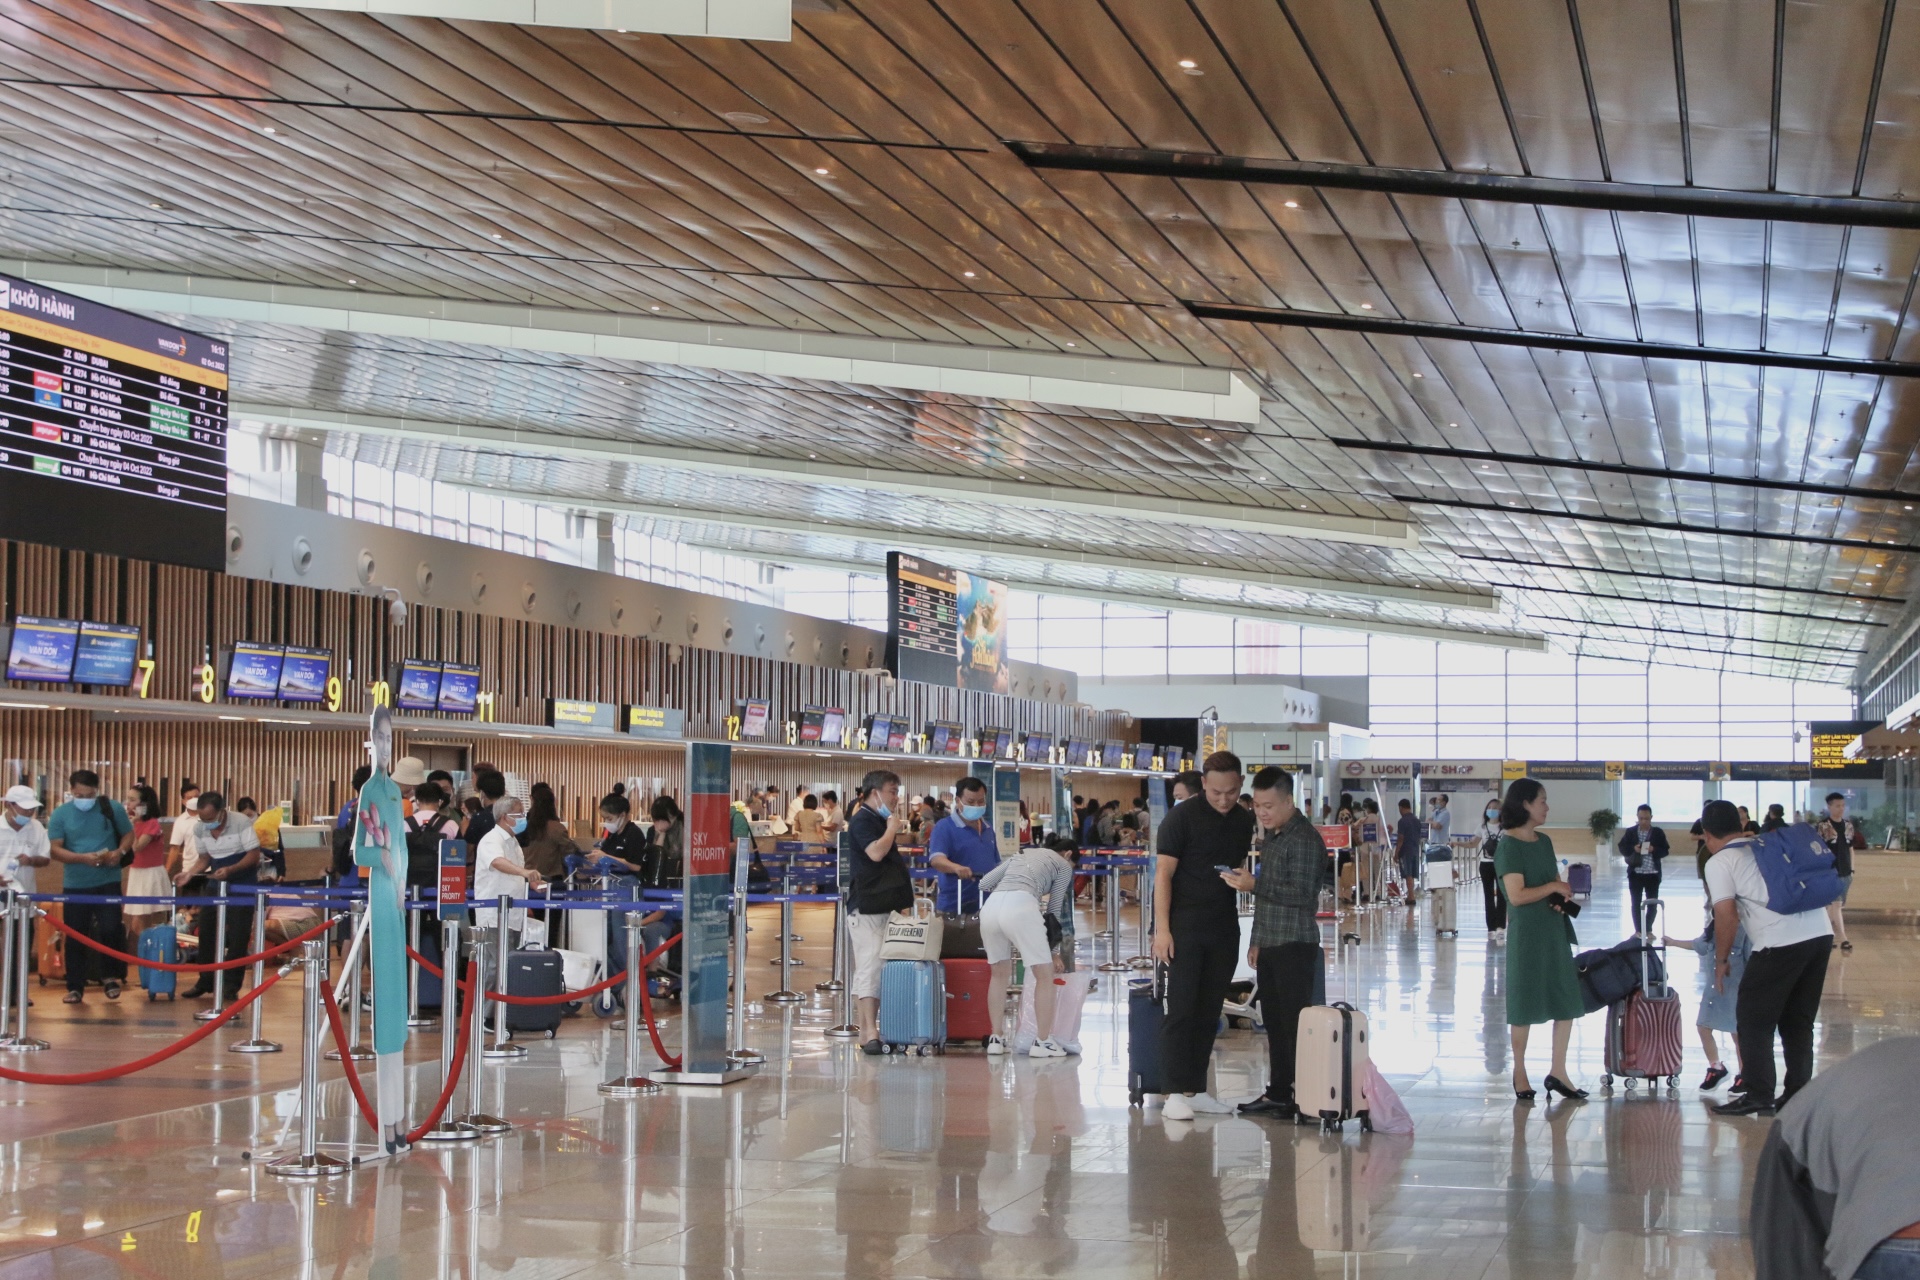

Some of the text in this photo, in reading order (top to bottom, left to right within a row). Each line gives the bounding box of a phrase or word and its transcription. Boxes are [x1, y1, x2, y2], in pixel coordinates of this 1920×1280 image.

[11, 288, 75, 320] KHỞI HÀNH
[0, 331, 10, 342] :00
[91, 356, 108, 368] DUBAI
[0, 366, 9, 376] :35
[109, 377, 122, 388] Minh
[0, 384, 9, 393] :35
[200, 386, 206, 395] 22
[109, 394, 122, 404] Minh
[217, 391, 221, 399] 7
[63, 398, 72, 408] VN
[108, 410, 122, 420] Minh
[216, 406, 221, 414] 4
[216, 421, 221, 430] 2
[140, 433, 153, 444] 2022
[108, 442, 121, 452] Minh
[0, 452, 9, 462] :50
[140, 466, 152, 476] 2022
[107, 475, 121, 484] Minh
[29, 646, 58, 656] VAN DON
[138, 660, 154, 699] 7
[201, 664, 214, 703] 8
[328, 677, 341, 712] 9
[371, 682, 390, 709] 10
[478, 691, 494, 722] 11
[727, 716, 740, 741] 12
[786, 721, 796, 746] 13
[840, 726, 850, 749] 14
[857, 728, 867, 750] 15
[917, 733, 926, 754] 17
[1371, 765, 1410, 774] LUCKY
[693, 832, 708, 846] SKY
[693, 847, 726, 861] PRIORITY
